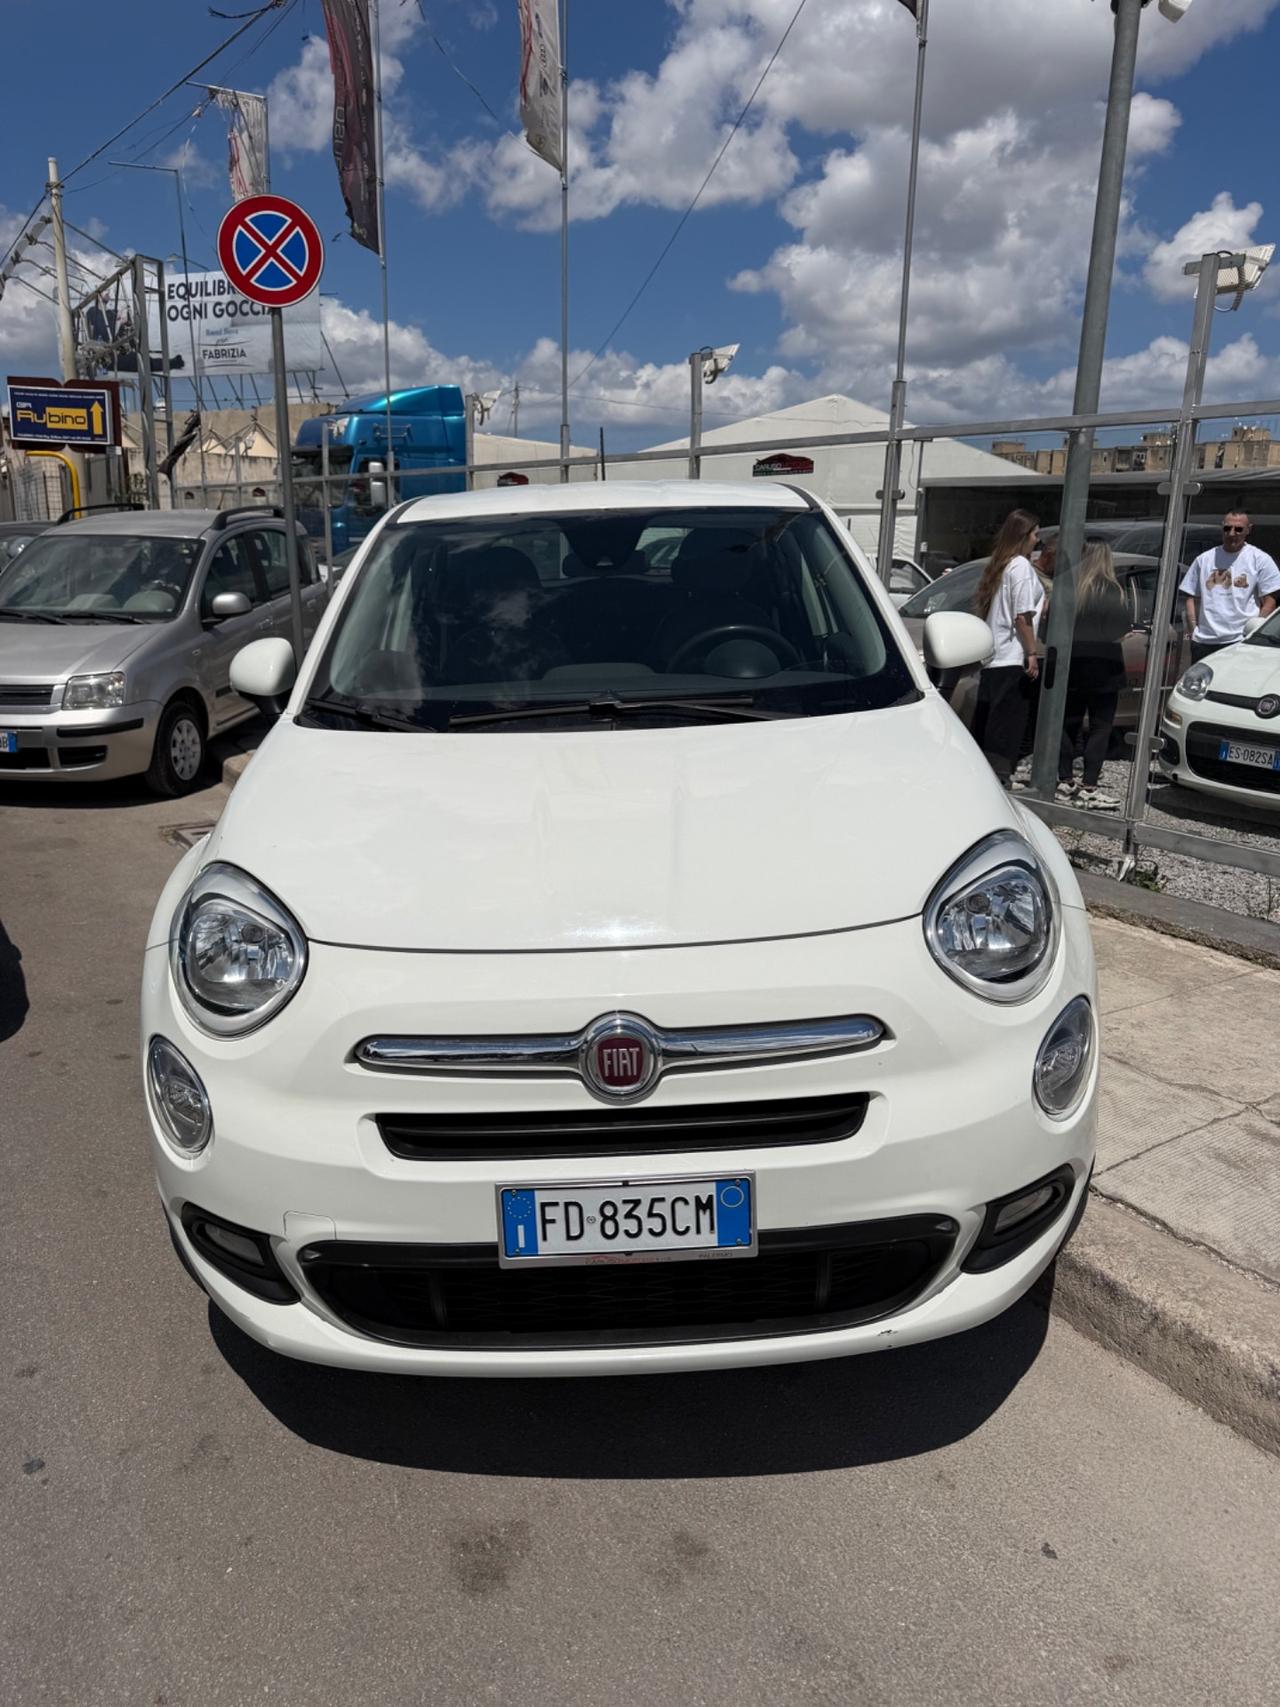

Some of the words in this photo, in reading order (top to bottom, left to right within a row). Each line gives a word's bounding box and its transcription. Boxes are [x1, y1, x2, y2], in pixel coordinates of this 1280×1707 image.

[167, 302, 208, 322] OGNI
[202, 348, 247, 360] FABRIZIA
[16, 409, 87, 426] Rubino
[602, 1047, 641, 1077] FIAT
